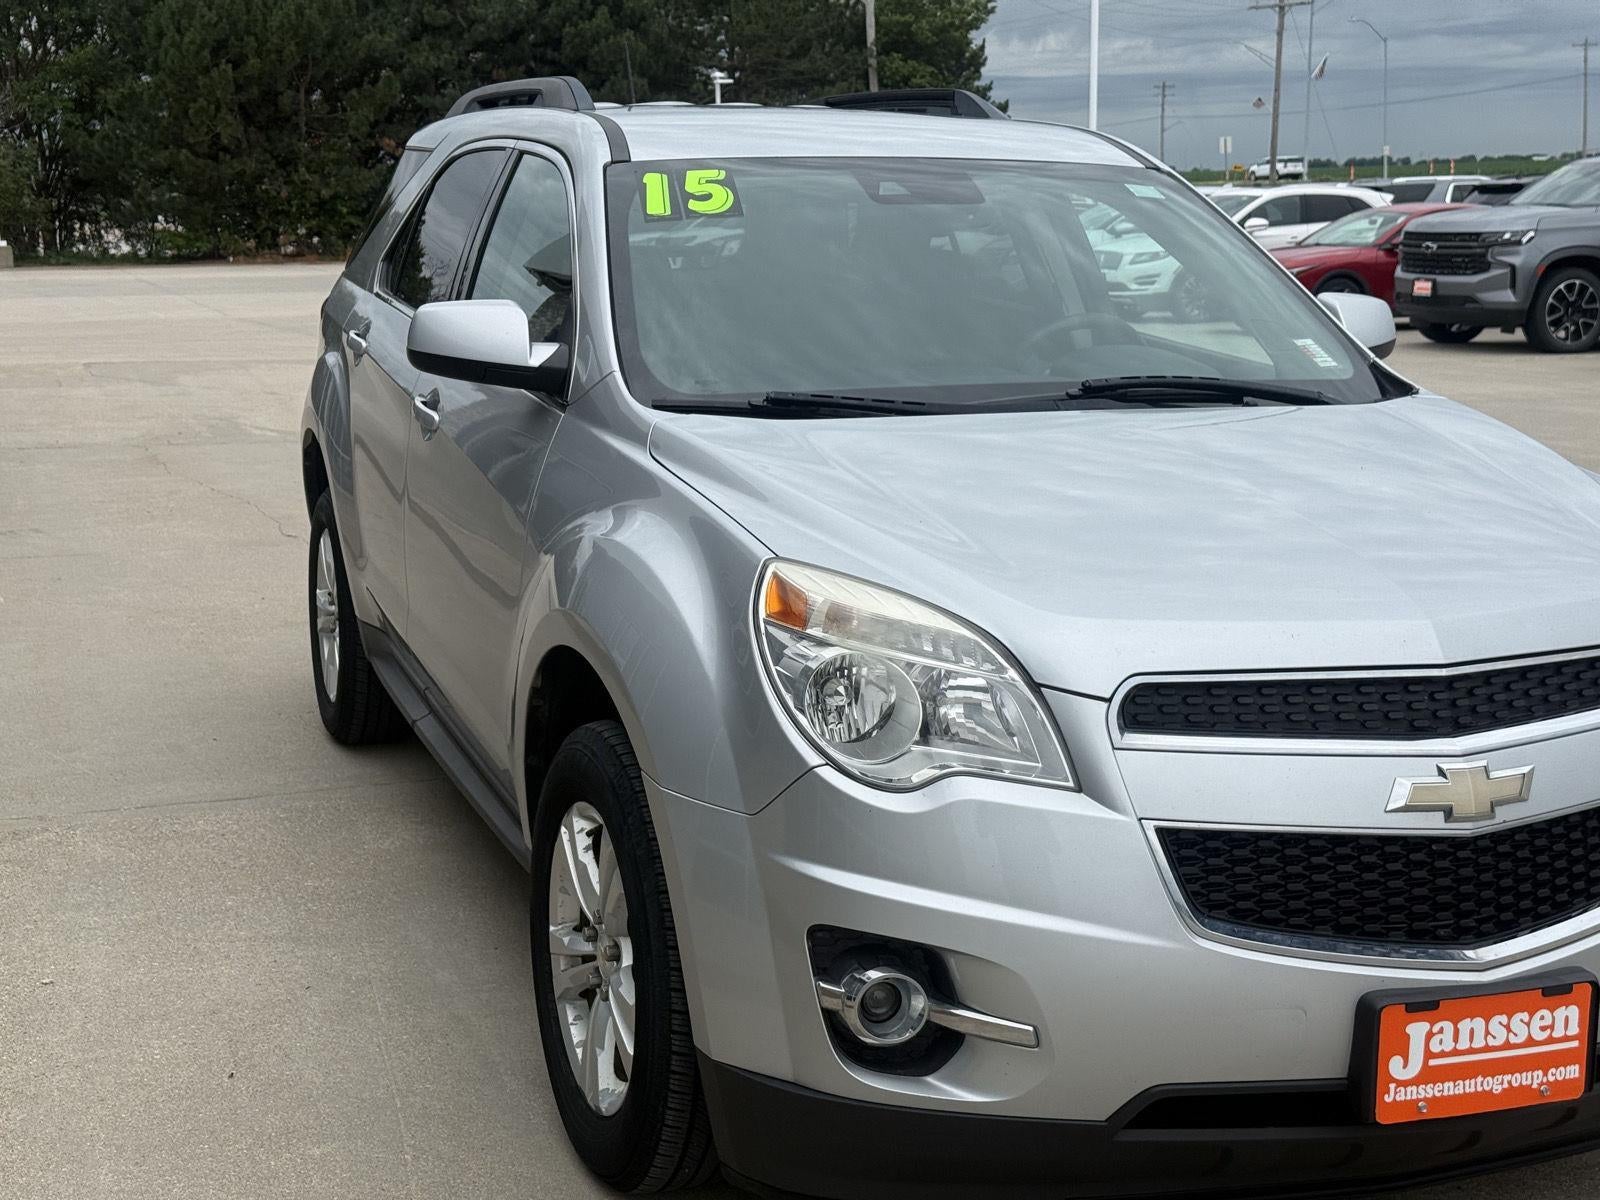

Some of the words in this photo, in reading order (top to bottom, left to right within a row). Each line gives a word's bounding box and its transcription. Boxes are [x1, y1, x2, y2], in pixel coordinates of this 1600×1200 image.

[643, 169, 734, 216] 15
[1388, 1004, 1579, 1080] Janssen
[1384, 1063, 1580, 1103] Janssenautogroup.com
